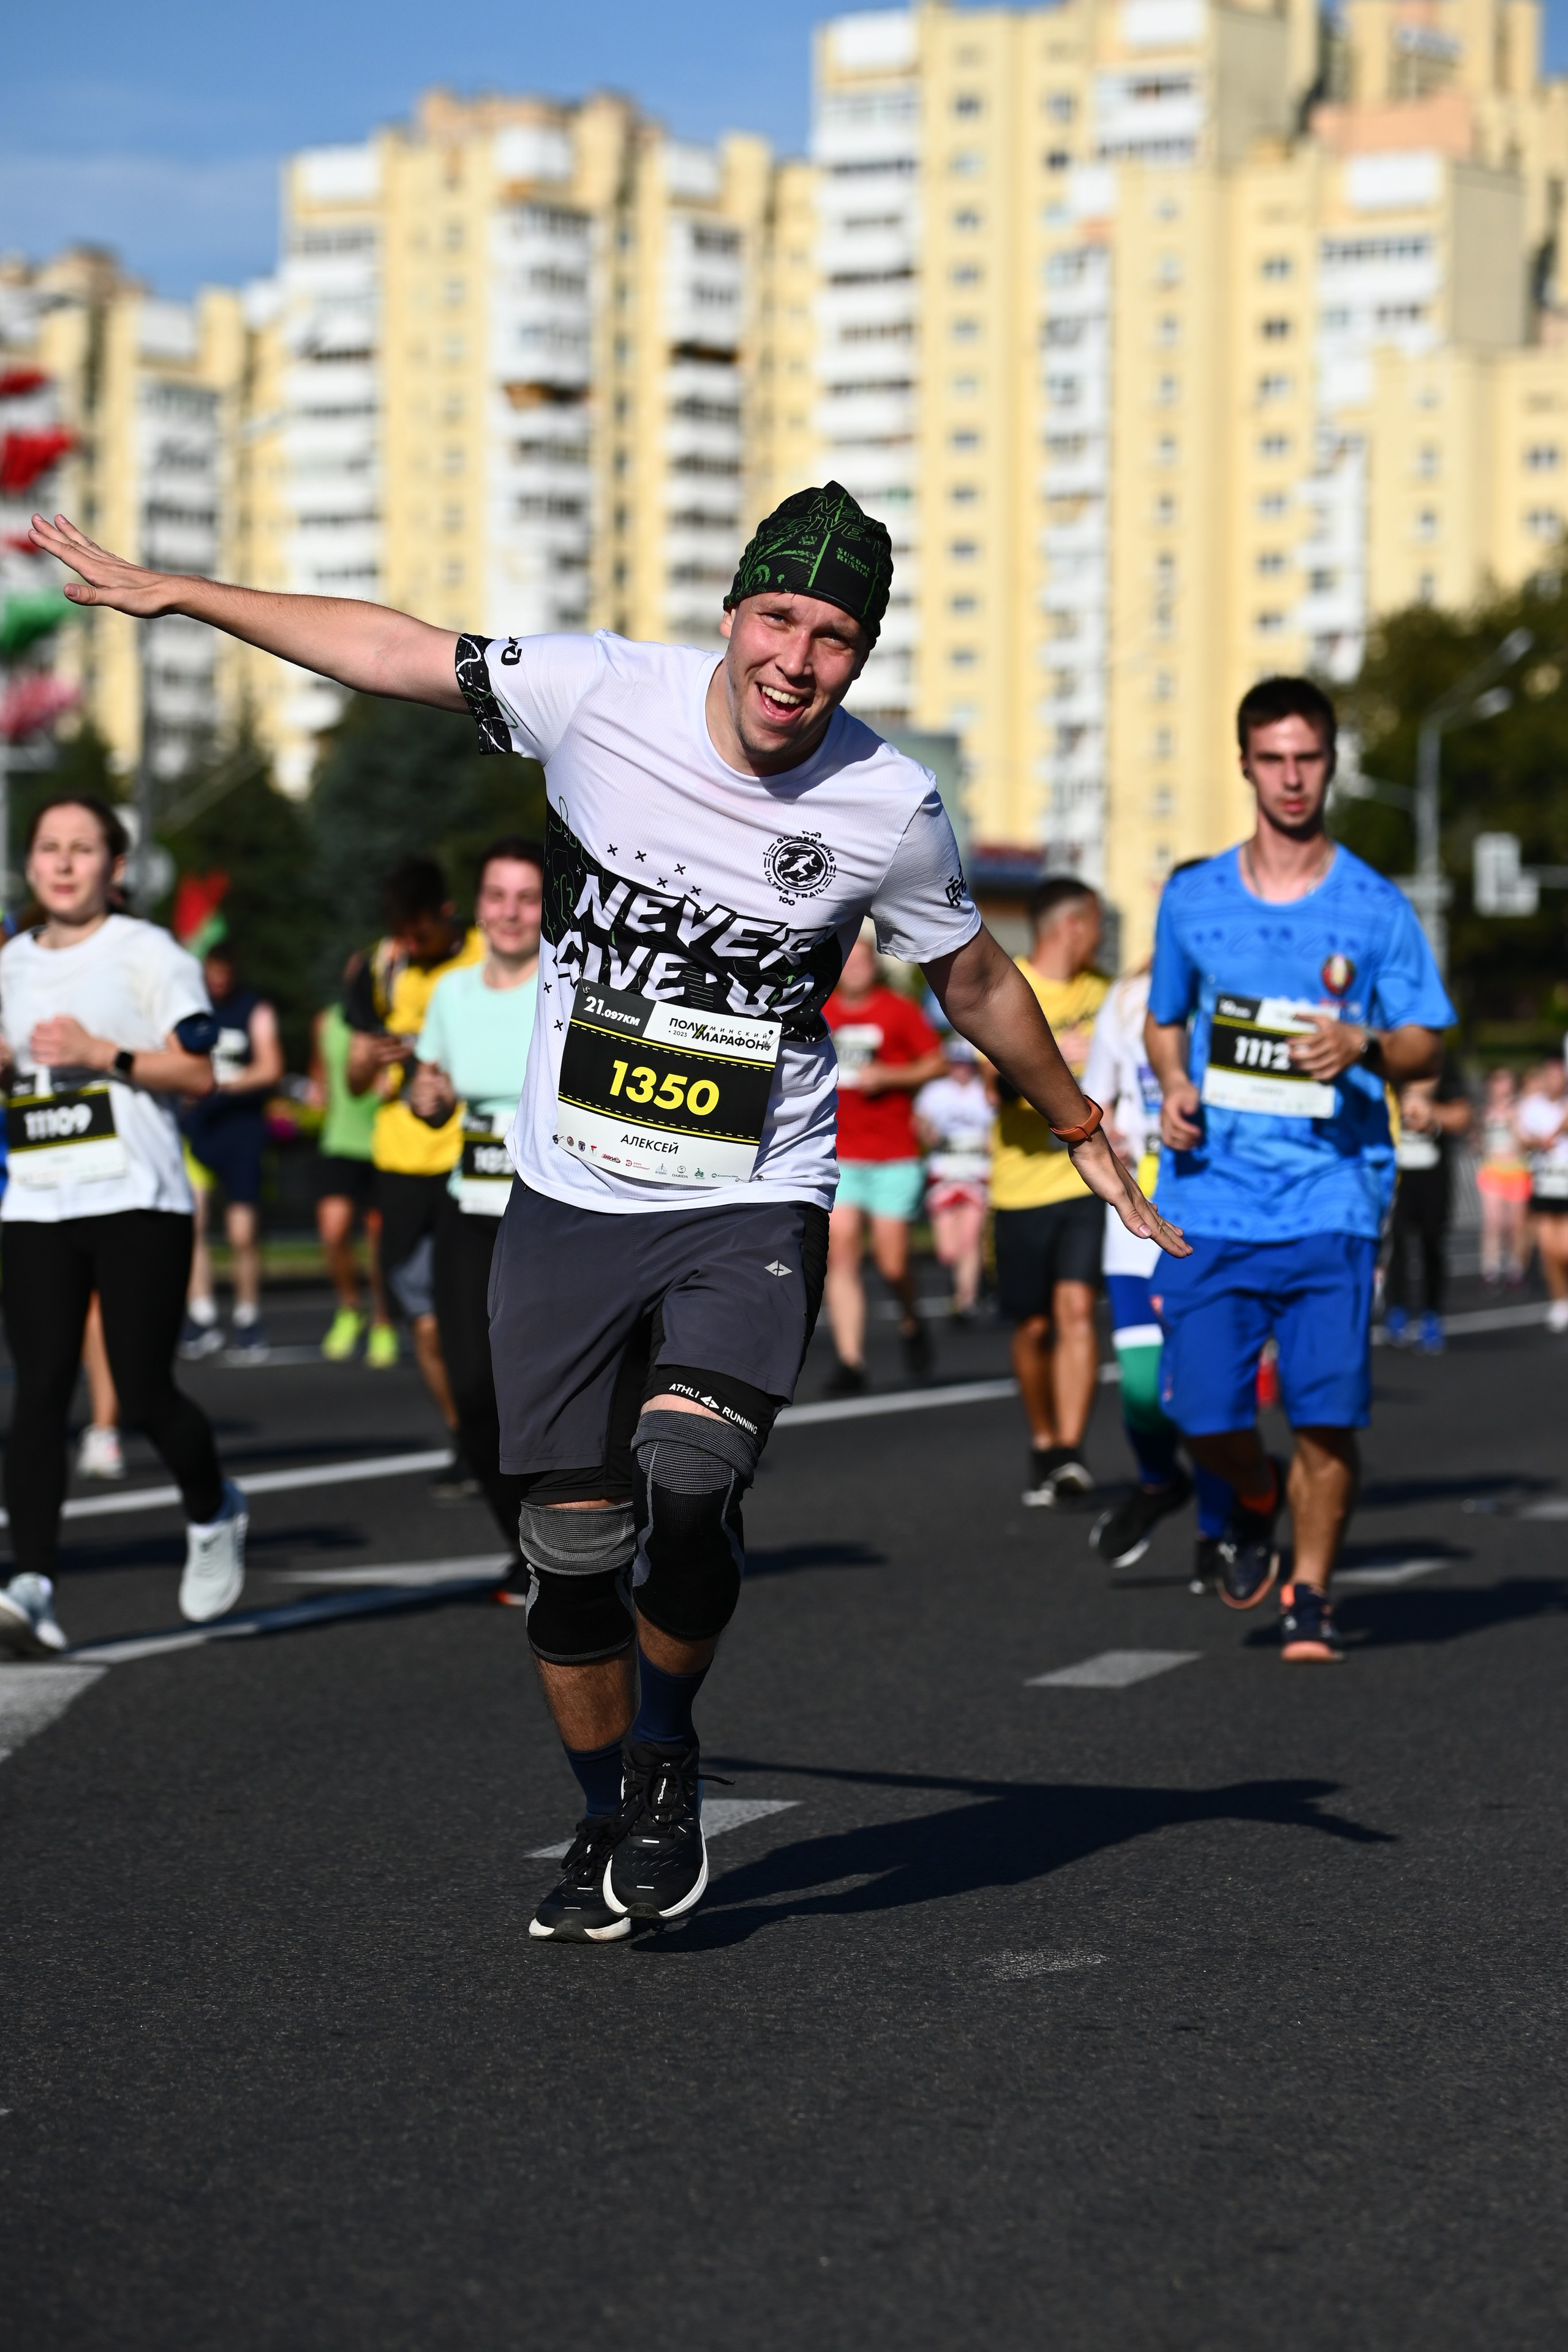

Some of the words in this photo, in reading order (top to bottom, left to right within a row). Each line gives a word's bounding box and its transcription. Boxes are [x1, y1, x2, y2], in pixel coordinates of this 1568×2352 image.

[778, 515, 865, 541] GIVE
[836, 553, 868, 578] RUSSIA
[777, 835, 818, 844] GOLDEN
[819, 843, 835, 863] RING
[764, 870, 790, 895] ULTRA
[794, 888, 825, 899] TRAIL
[778, 895, 796, 906] 100
[573, 873, 826, 971] NEVER
[669, 1017, 709, 1039] ПОЛУ
[709, 1025, 768, 1039] МИНСКИЙ
[609, 1059, 720, 1116] 1350
[23, 1102, 92, 1142] 11109
[620, 1134, 679, 1155] АЛЕКСЕЙ
[668, 1383, 700, 1398] ATHLI
[722, 1406, 758, 1435] RUNNING
